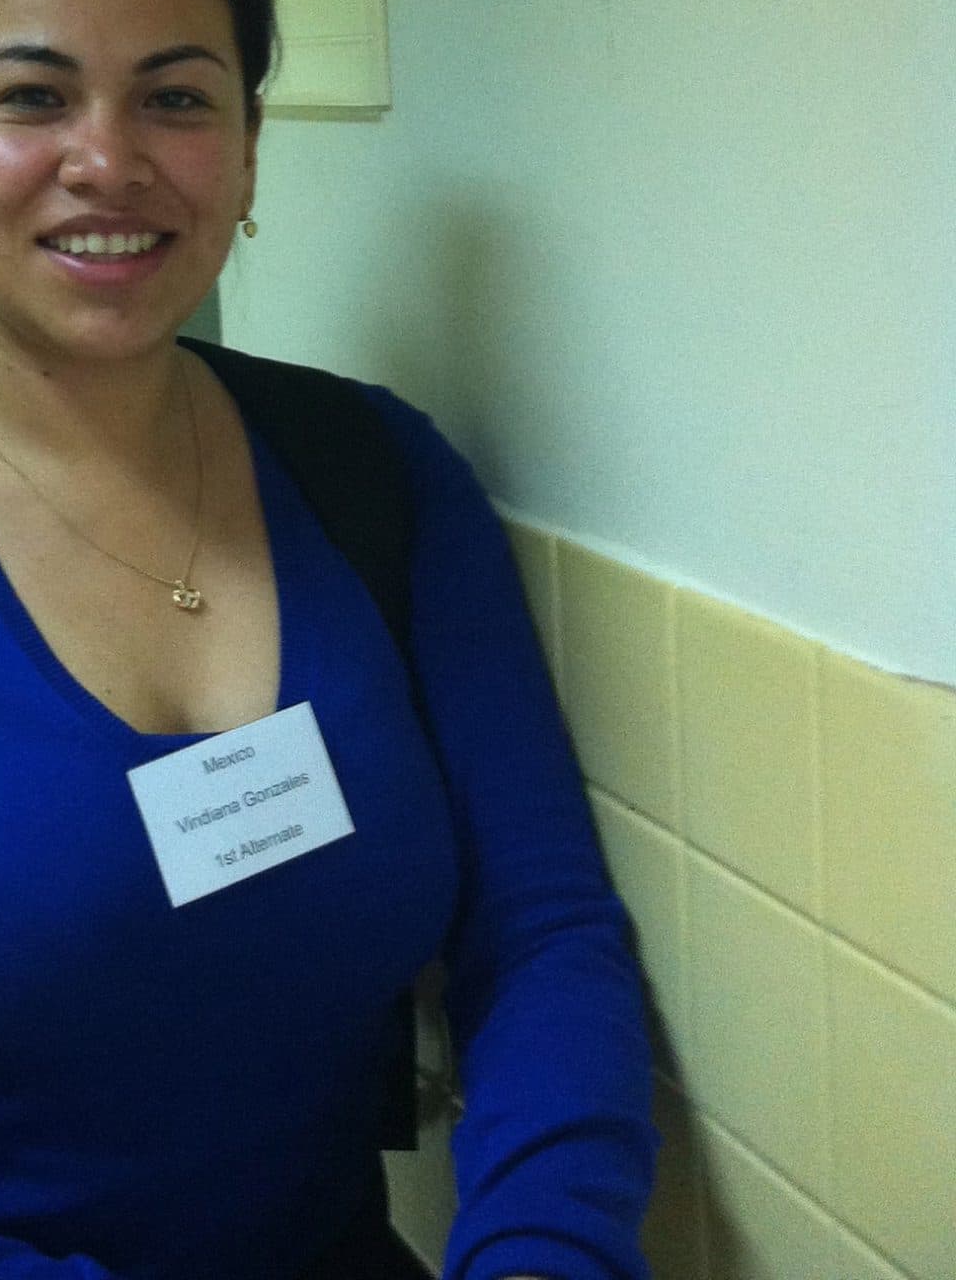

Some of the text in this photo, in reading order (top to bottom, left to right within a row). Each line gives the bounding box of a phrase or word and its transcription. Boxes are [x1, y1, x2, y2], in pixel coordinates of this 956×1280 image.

[201, 746, 256, 775] Mexico
[243, 771, 310, 807] Gonzales
[215, 822, 304, 868] 1st Alternate
